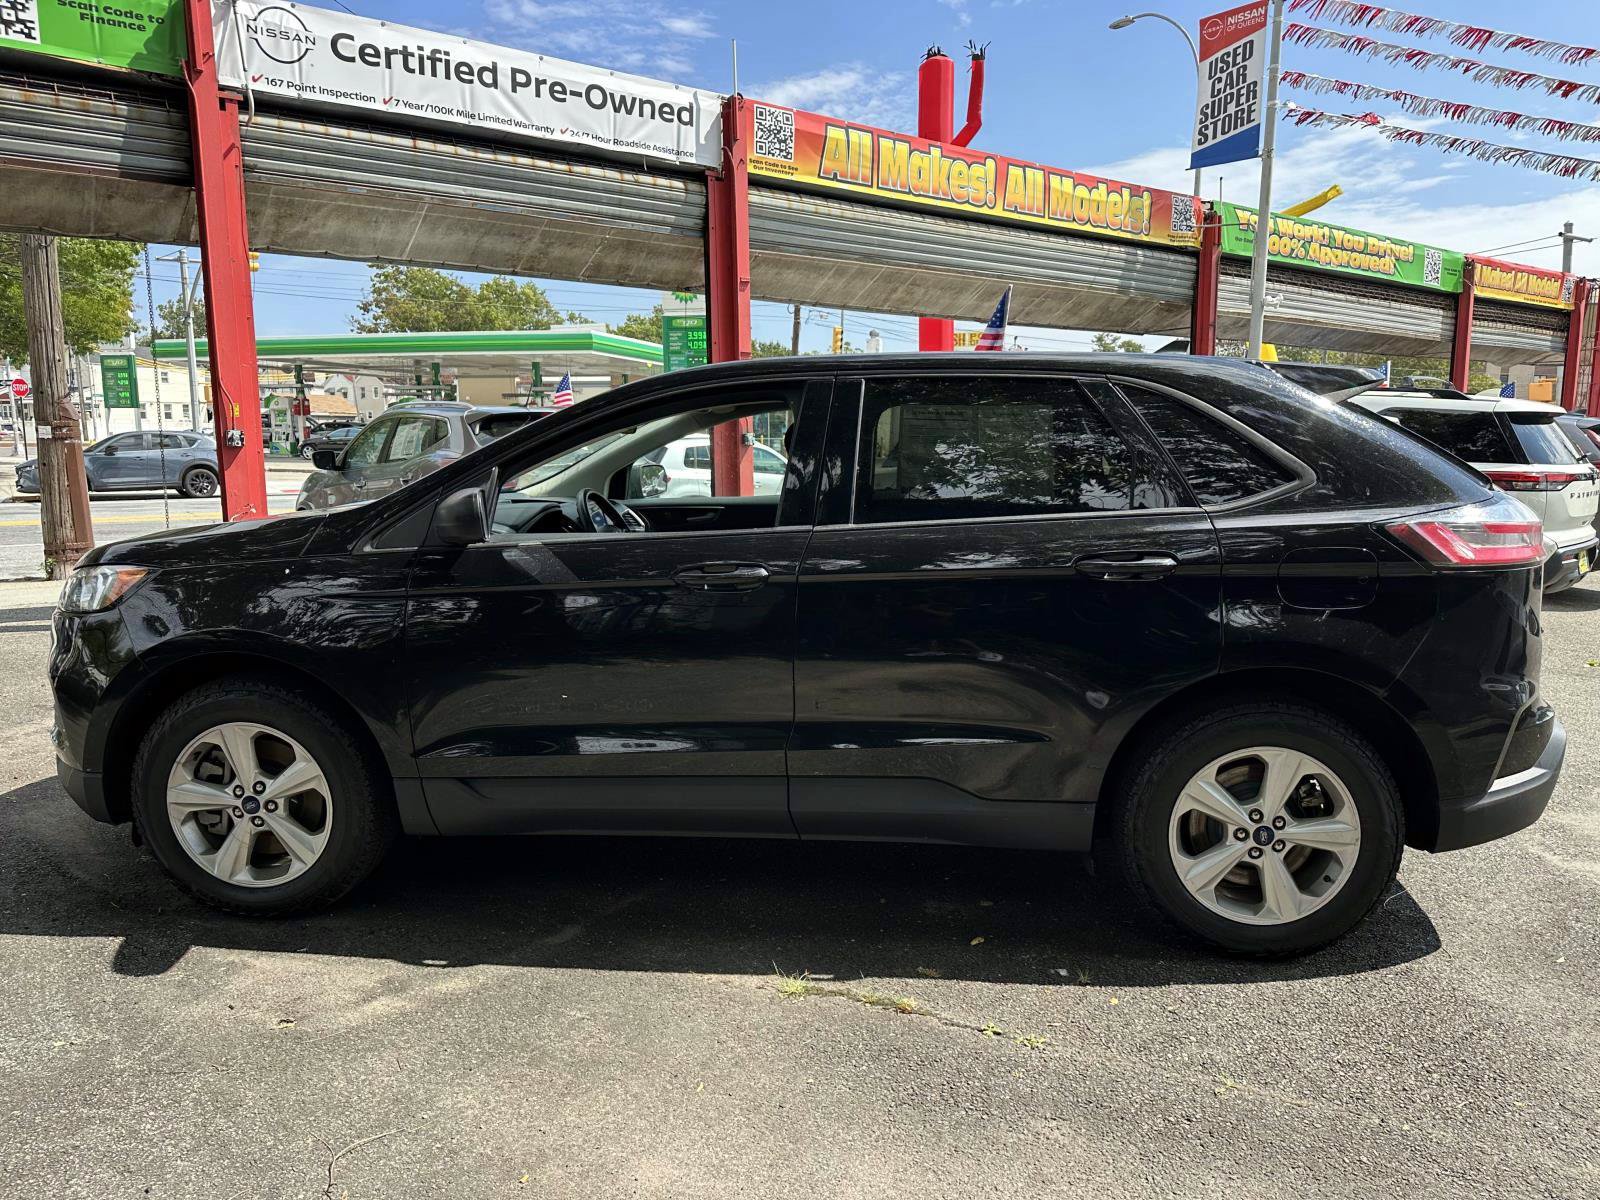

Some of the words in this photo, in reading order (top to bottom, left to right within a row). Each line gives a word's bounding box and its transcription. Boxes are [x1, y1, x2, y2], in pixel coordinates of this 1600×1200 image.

[79, 12, 147, 32] Finance
[103, 5, 144, 20] Code
[147, 14, 165, 25] to
[1227, 24, 1237, 32] OF
[1237, 15, 1265, 30] QUEENS
[1228, 6, 1265, 25] NISSAN
[247, 23, 316, 46] NISSAN
[1203, 25, 1224, 35] NISSAN
[1208, 39, 1254, 81] USED
[264, 77, 284, 88] 167
[286, 82, 317, 94] Point
[318, 86, 376, 104] Inspection
[330, 32, 498, 90] Certified
[510, 66, 694, 127] Pre-Owned
[1210, 64, 1248, 99] CAR
[1199, 80, 1258, 125] SUPER
[394, 99, 401, 107] 7
[402, 100, 455, 116] Year/100K
[456, 109, 476, 120] Mile
[478, 112, 513, 126] Limited
[513, 119, 555, 135] Warranty
[1197, 101, 1257, 146] STORE
[591, 134, 612, 145] Hour
[613, 138, 652, 151] Roadside
[653, 144, 695, 158] Assistance
[764, 160, 780, 168] Code
[818, 123, 873, 187] All
[877, 134, 998, 209] Makes!
[1003, 162, 1045, 217] All
[1048, 171, 1152, 236] Models!
[1276, 217, 1330, 246] Work!
[1332, 228, 1365, 252] You
[1367, 236, 1414, 262] Drive!
[1265, 234, 1306, 259] 00%
[1308, 240, 1396, 275] Approved!
[12, 383, 28, 391] STOP
